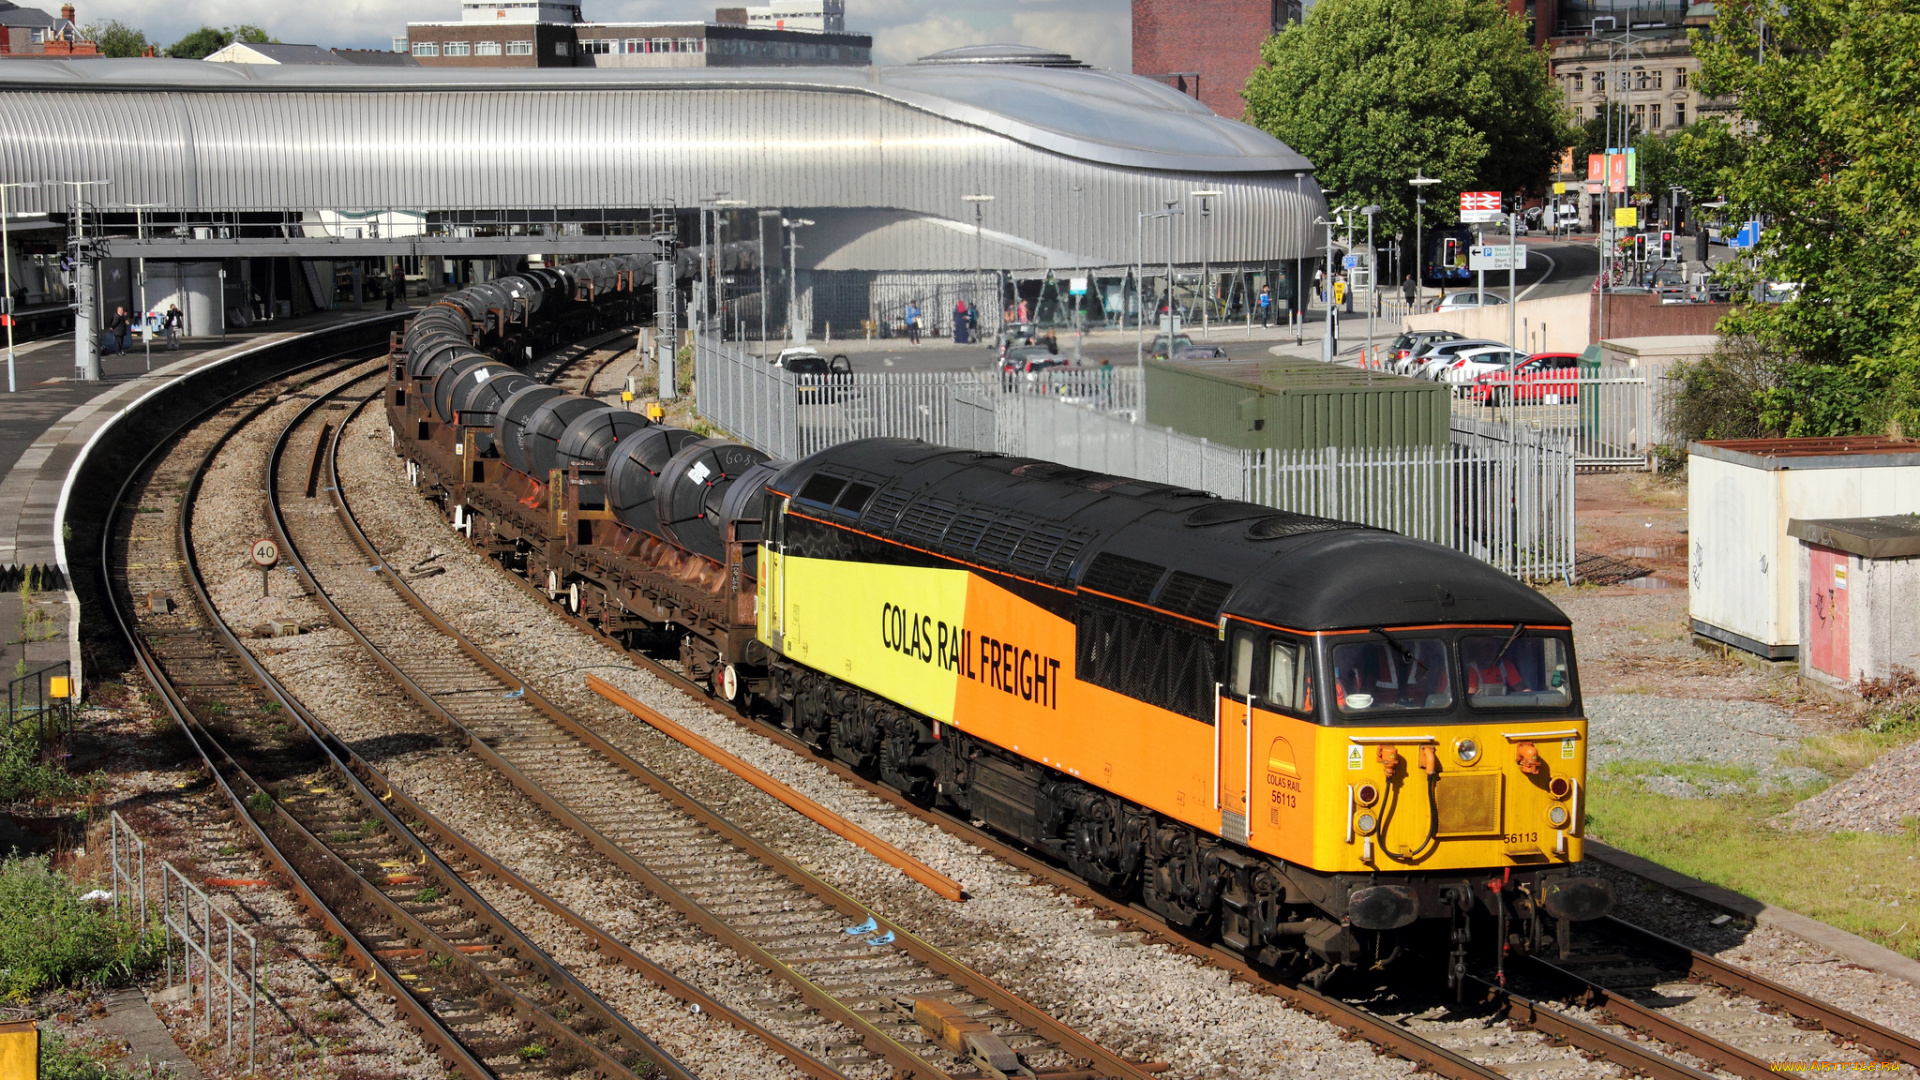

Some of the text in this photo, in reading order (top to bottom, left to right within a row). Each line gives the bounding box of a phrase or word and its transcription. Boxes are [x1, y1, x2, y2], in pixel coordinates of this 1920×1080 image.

[256, 546, 275, 558] 40
[882, 601, 1061, 711] COLAS RAIL FREIGHT
[1266, 773, 1301, 793] COLAS RAIL
[1271, 789, 1297, 809] 56113
[1503, 832, 1538, 844] 56113
